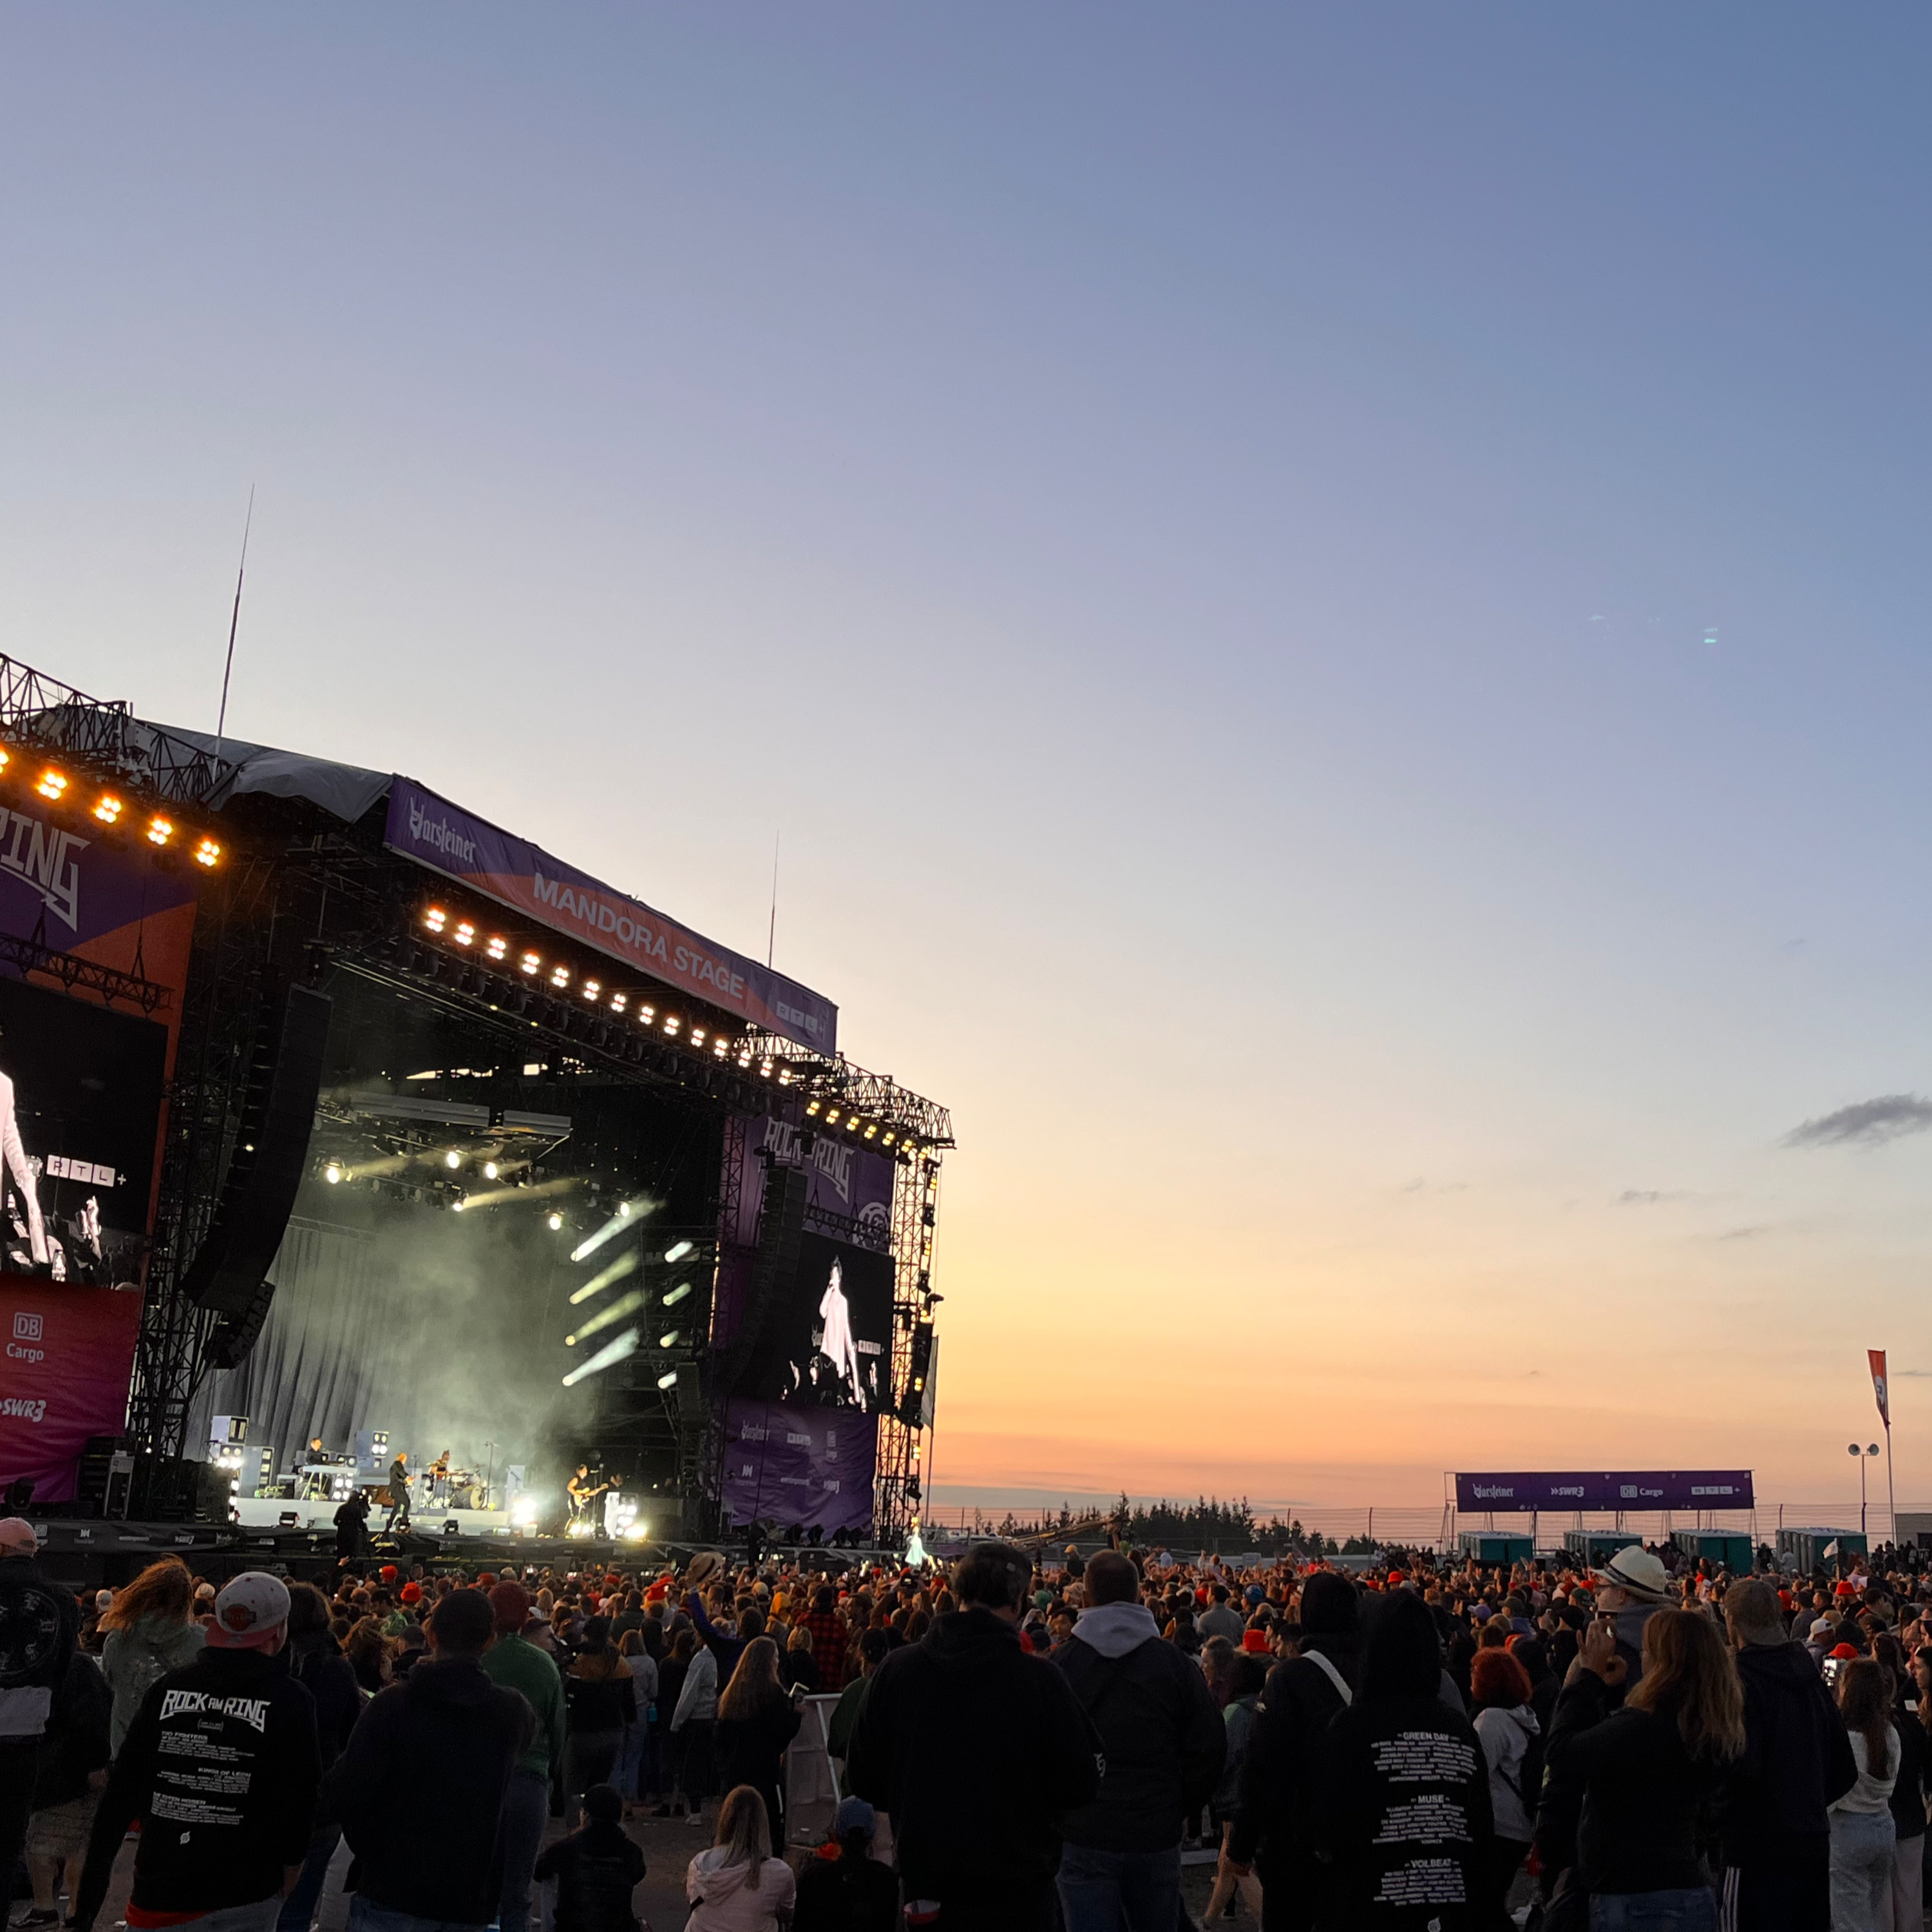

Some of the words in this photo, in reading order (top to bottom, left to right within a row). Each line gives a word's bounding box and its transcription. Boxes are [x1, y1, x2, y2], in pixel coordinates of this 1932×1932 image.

[410, 797, 477, 863] Warsteiner
[533, 872, 668, 963] MANDORA
[673, 945, 744, 999] STAGE
[813, 1137, 855, 1204] RING
[15, 1314, 41, 1338] DB
[6, 1343, 44, 1364] Cargo
[1621, 1486, 1636, 1497] DB
[1640, 1488, 1663, 1497] Cargo
[160, 1690, 209, 1720] ROCK
[223, 1697, 271, 1733] RING
[1403, 1732, 1432, 1741] GREEN
[1433, 1732, 1449, 1741] DAY
[1418, 1794, 1444, 1804] MUSE
